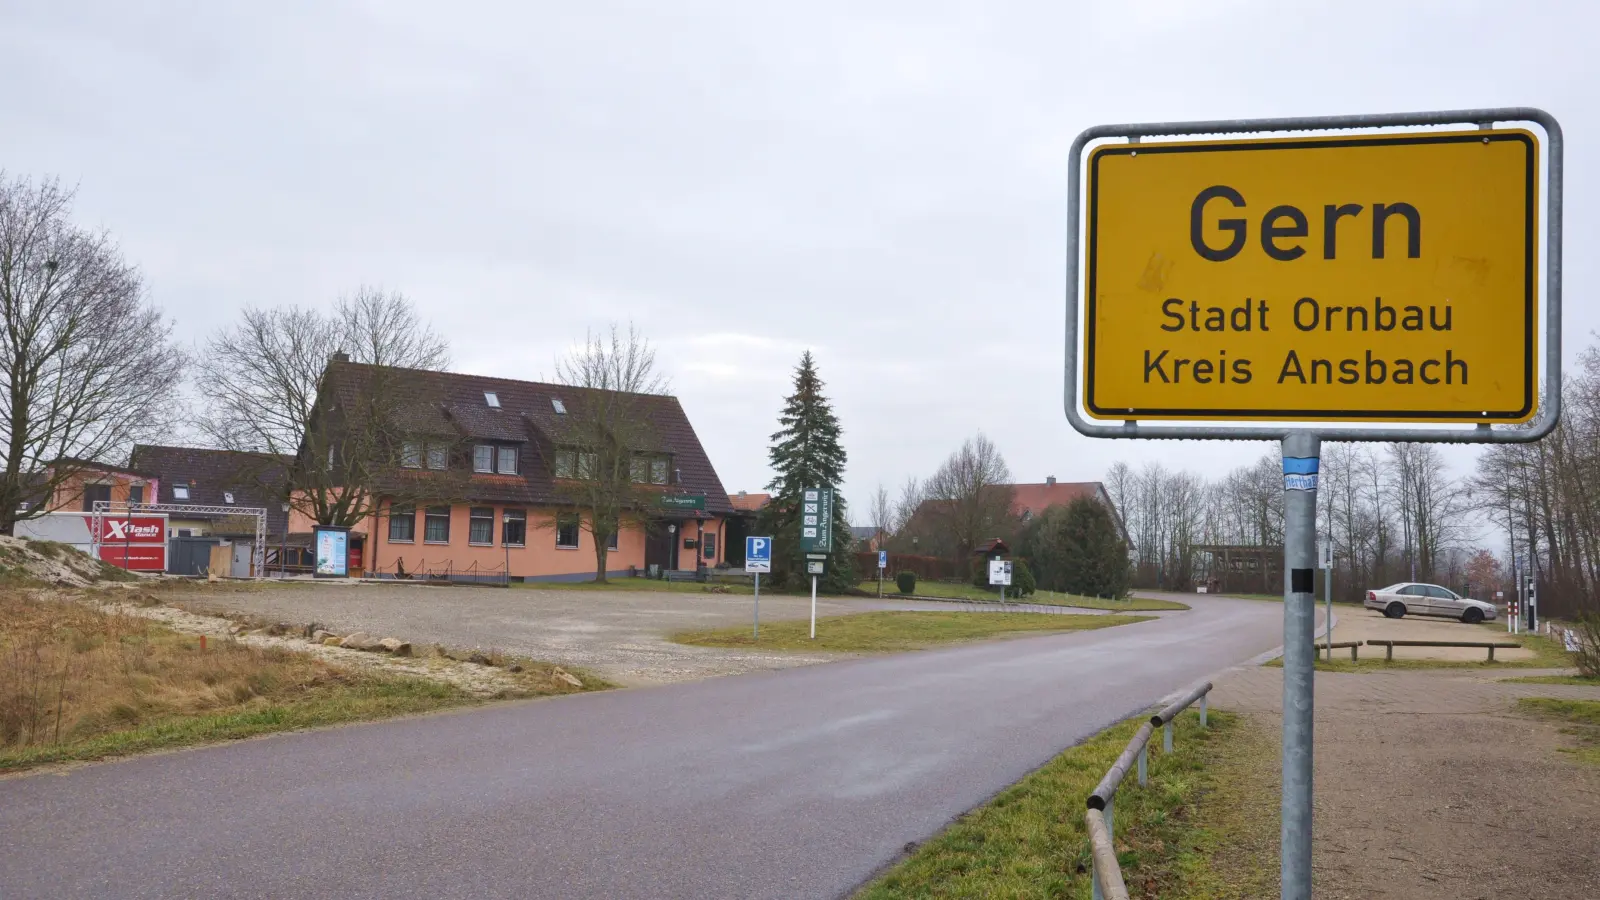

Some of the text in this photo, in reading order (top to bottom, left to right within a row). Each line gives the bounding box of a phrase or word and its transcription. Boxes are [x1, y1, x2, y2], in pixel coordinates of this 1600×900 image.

[1190, 185, 1420, 262] Gern
[1160, 297, 1452, 332] Stadt Ornbau
[1143, 349, 1468, 385] Kreis Ansbach
[753, 538, 765, 555] P
